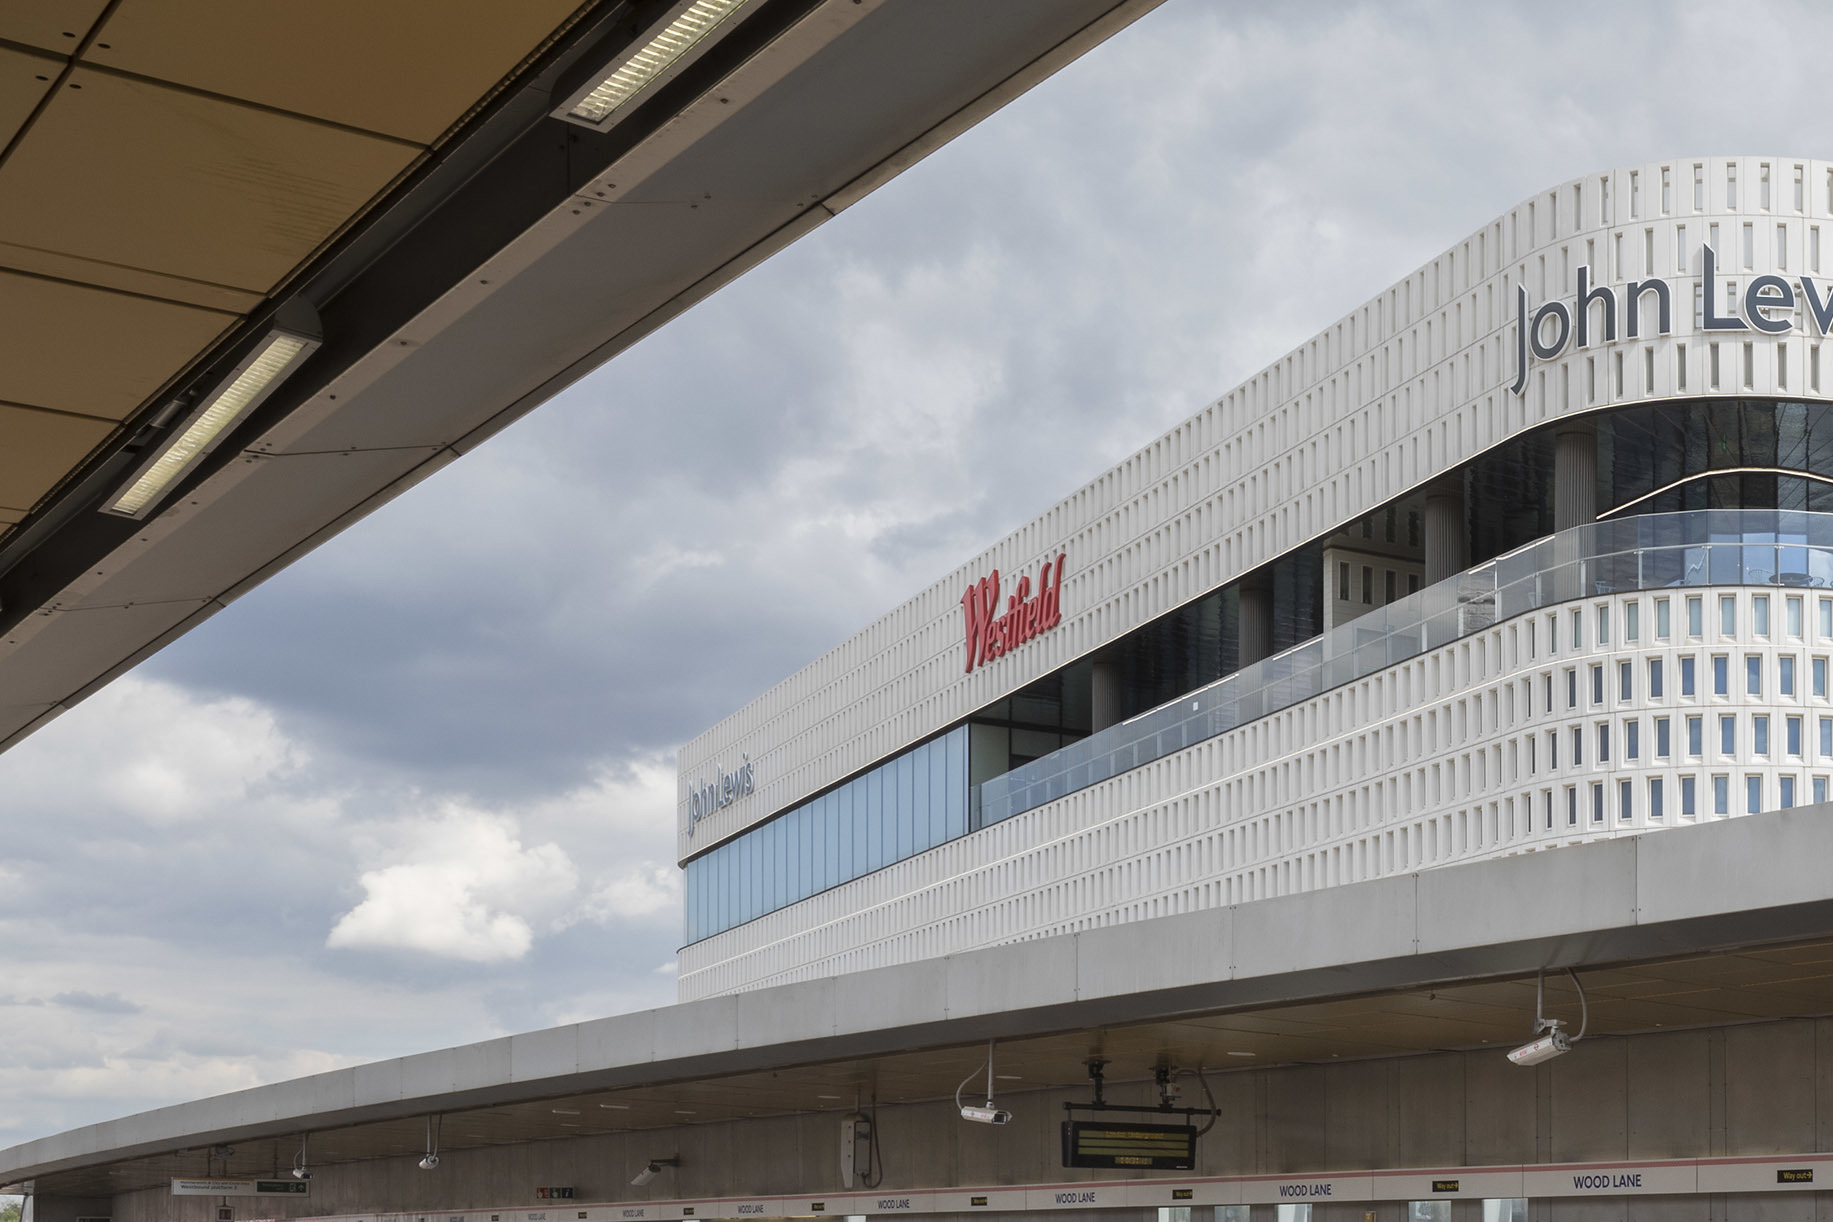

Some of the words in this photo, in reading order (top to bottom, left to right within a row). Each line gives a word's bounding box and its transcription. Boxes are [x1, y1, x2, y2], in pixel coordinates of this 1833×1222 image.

[1509, 263, 1673, 396] John
[960, 553, 1067, 674] Westfield
[688, 776, 715, 838] John
[717, 752, 754, 809] Lewis
[1573, 1175, 1609, 1189] WOOD
[1613, 1174, 1642, 1188] LANE
[1783, 1172, 1796, 1181] Way
[1796, 1171, 1807, 1179] out
[1279, 1185, 1307, 1197] WOOD
[1309, 1184, 1332, 1196] LANE
[877, 1200, 896, 1209] WOOD
[898, 1199, 910, 1208] LANE
[1055, 1193, 1077, 1204] WOOD
[1078, 1192, 1095, 1203] LANE
